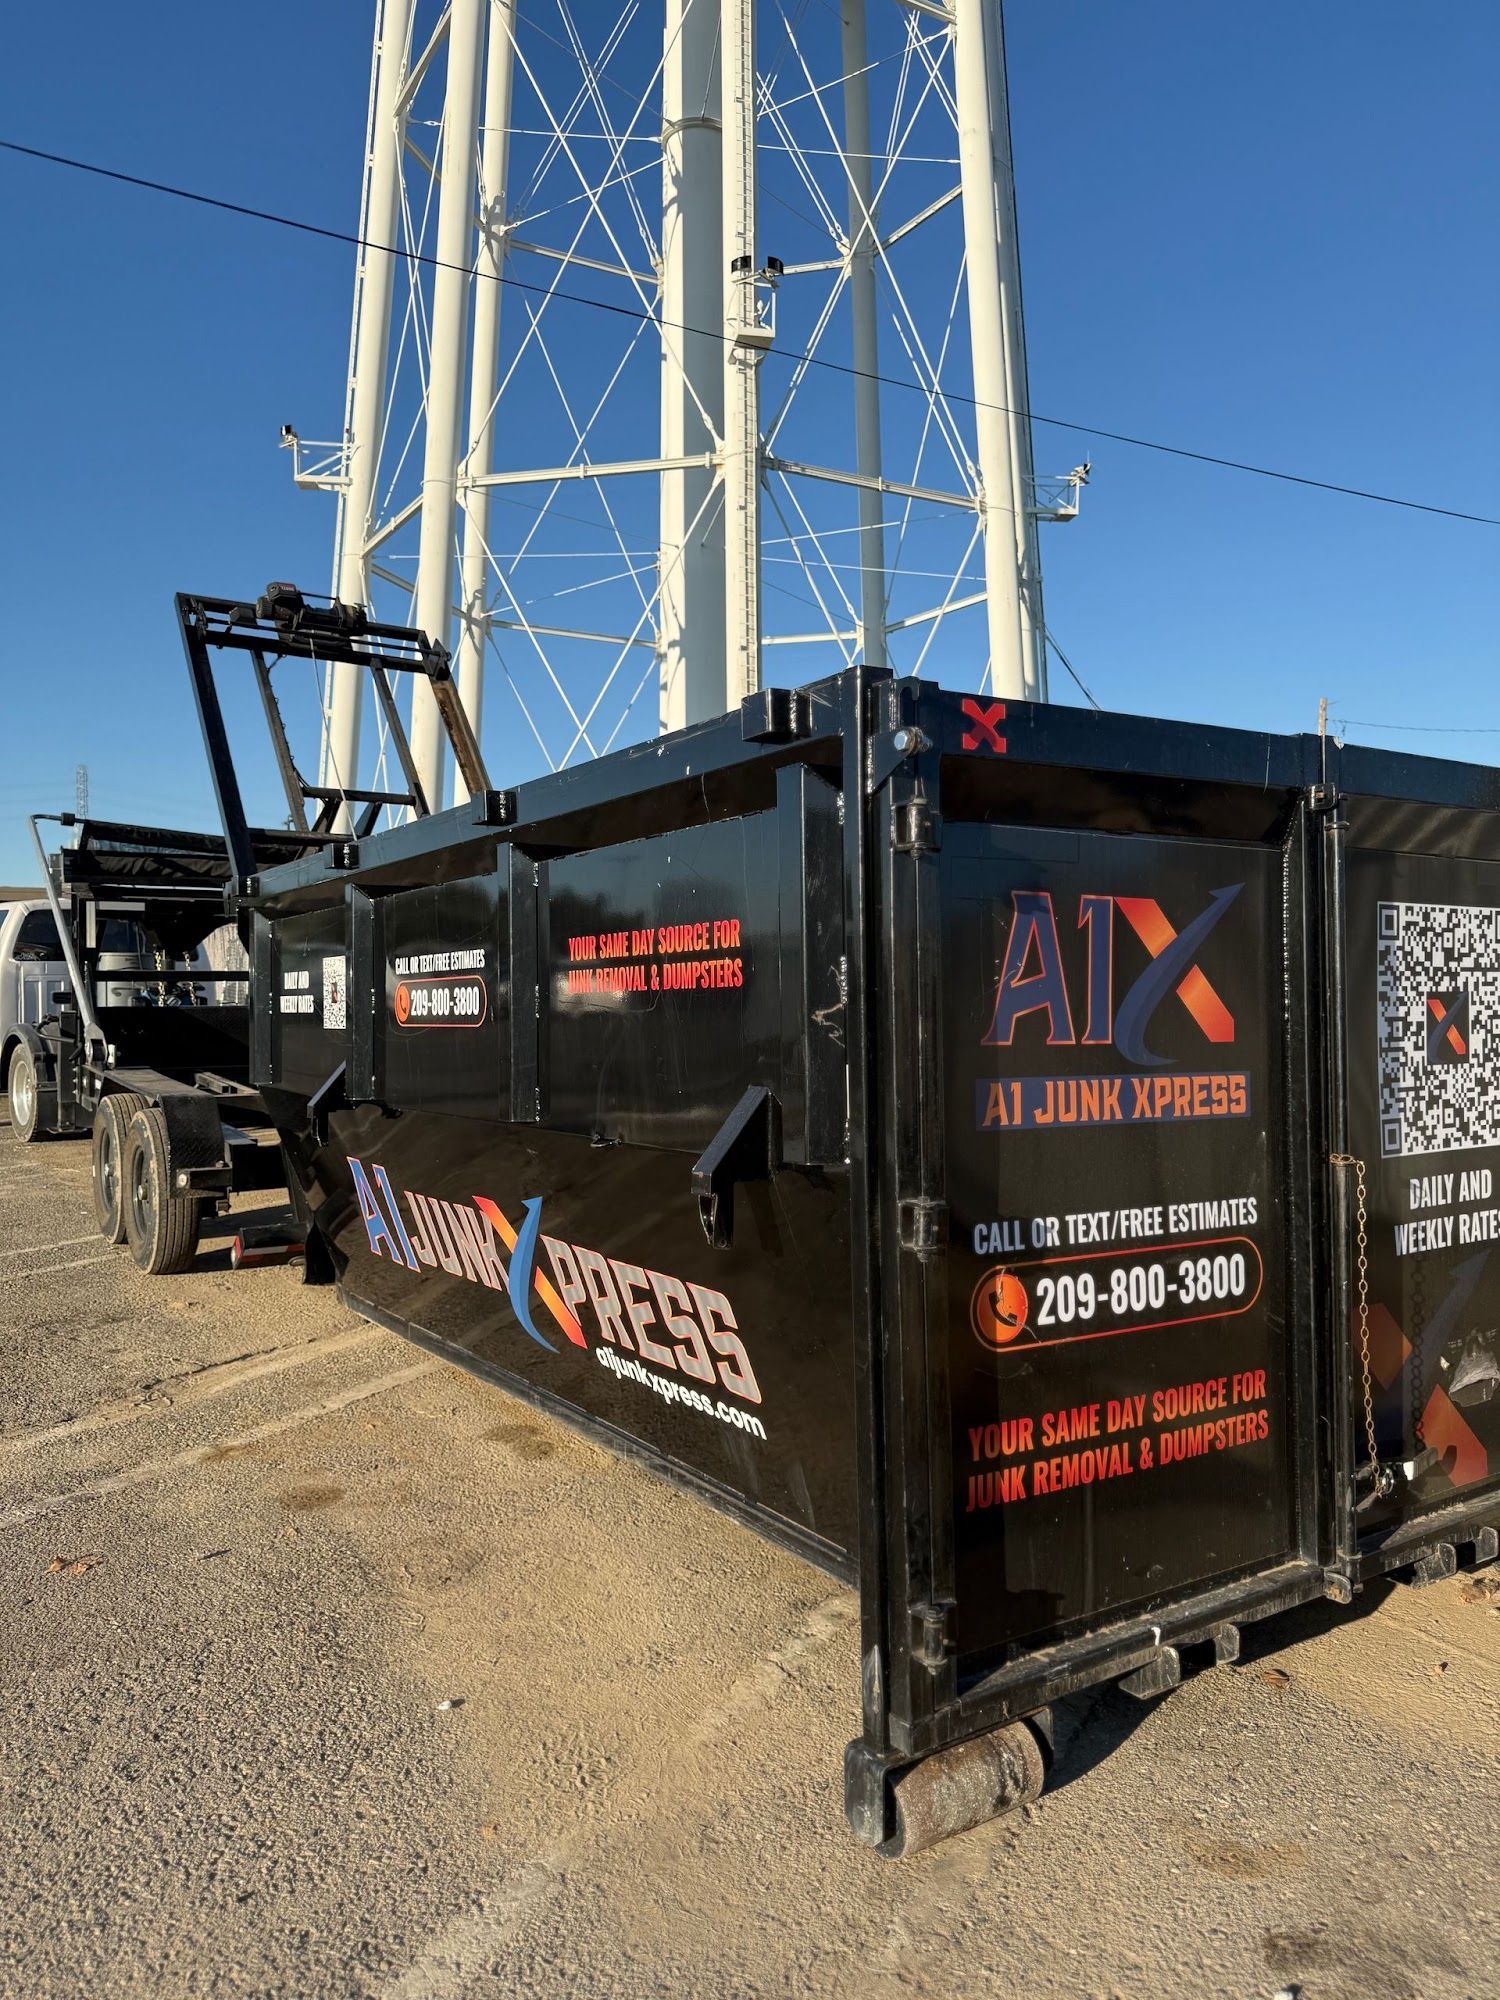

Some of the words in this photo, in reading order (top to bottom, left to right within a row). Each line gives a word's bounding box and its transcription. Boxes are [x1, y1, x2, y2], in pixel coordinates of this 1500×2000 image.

[395, 957, 410, 975] CALL
[410, 956, 420, 974] OR
[450, 948, 485, 971] ESTIMATES
[568, 935, 597, 962] YOUR
[599, 931, 629, 959] SAME
[631, 929, 655, 956] DAY
[658, 922, 710, 954] SOURCE
[713, 918, 741, 949] FOR
[567, 969, 593, 994] JUNK
[596, 965, 648, 993] REMOVAL
[650, 964, 660, 991] &
[663, 957, 743, 990] DUMPSTERS
[410, 986, 480, 1017] 209-800-3800
[982, 1082, 1022, 1128] A1
[1033, 1080, 1124, 1124] JUNK
[1130, 1074, 1248, 1119] XPRESS
[1409, 1173, 1454, 1210] DAILY
[1458, 1168, 1492, 1202] AND
[346, 1156, 421, 1273] A1
[973, 1219, 1025, 1255] CALL
[1031, 1216, 1060, 1248] OR
[1065, 1205, 1164, 1243] TEXT/FREE
[1168, 1197, 1258, 1234] ESTIMATES
[1394, 1216, 1454, 1256] WEEKLY
[1036, 1253, 1246, 1326] 209-800-3800
[968, 1417, 1034, 1461] YOUR
[1041, 1403, 1101, 1447] SAME
[1107, 1394, 1146, 1433] DAY
[1152, 1377, 1228, 1423] SOURCE
[1232, 1369, 1267, 1402] FOR
[966, 1465, 1027, 1513] JUNK
[1033, 1442, 1134, 1495] REMOVAL
[1139, 1437, 1153, 1470] &
[1160, 1409, 1269, 1465] DUMPSTERS
